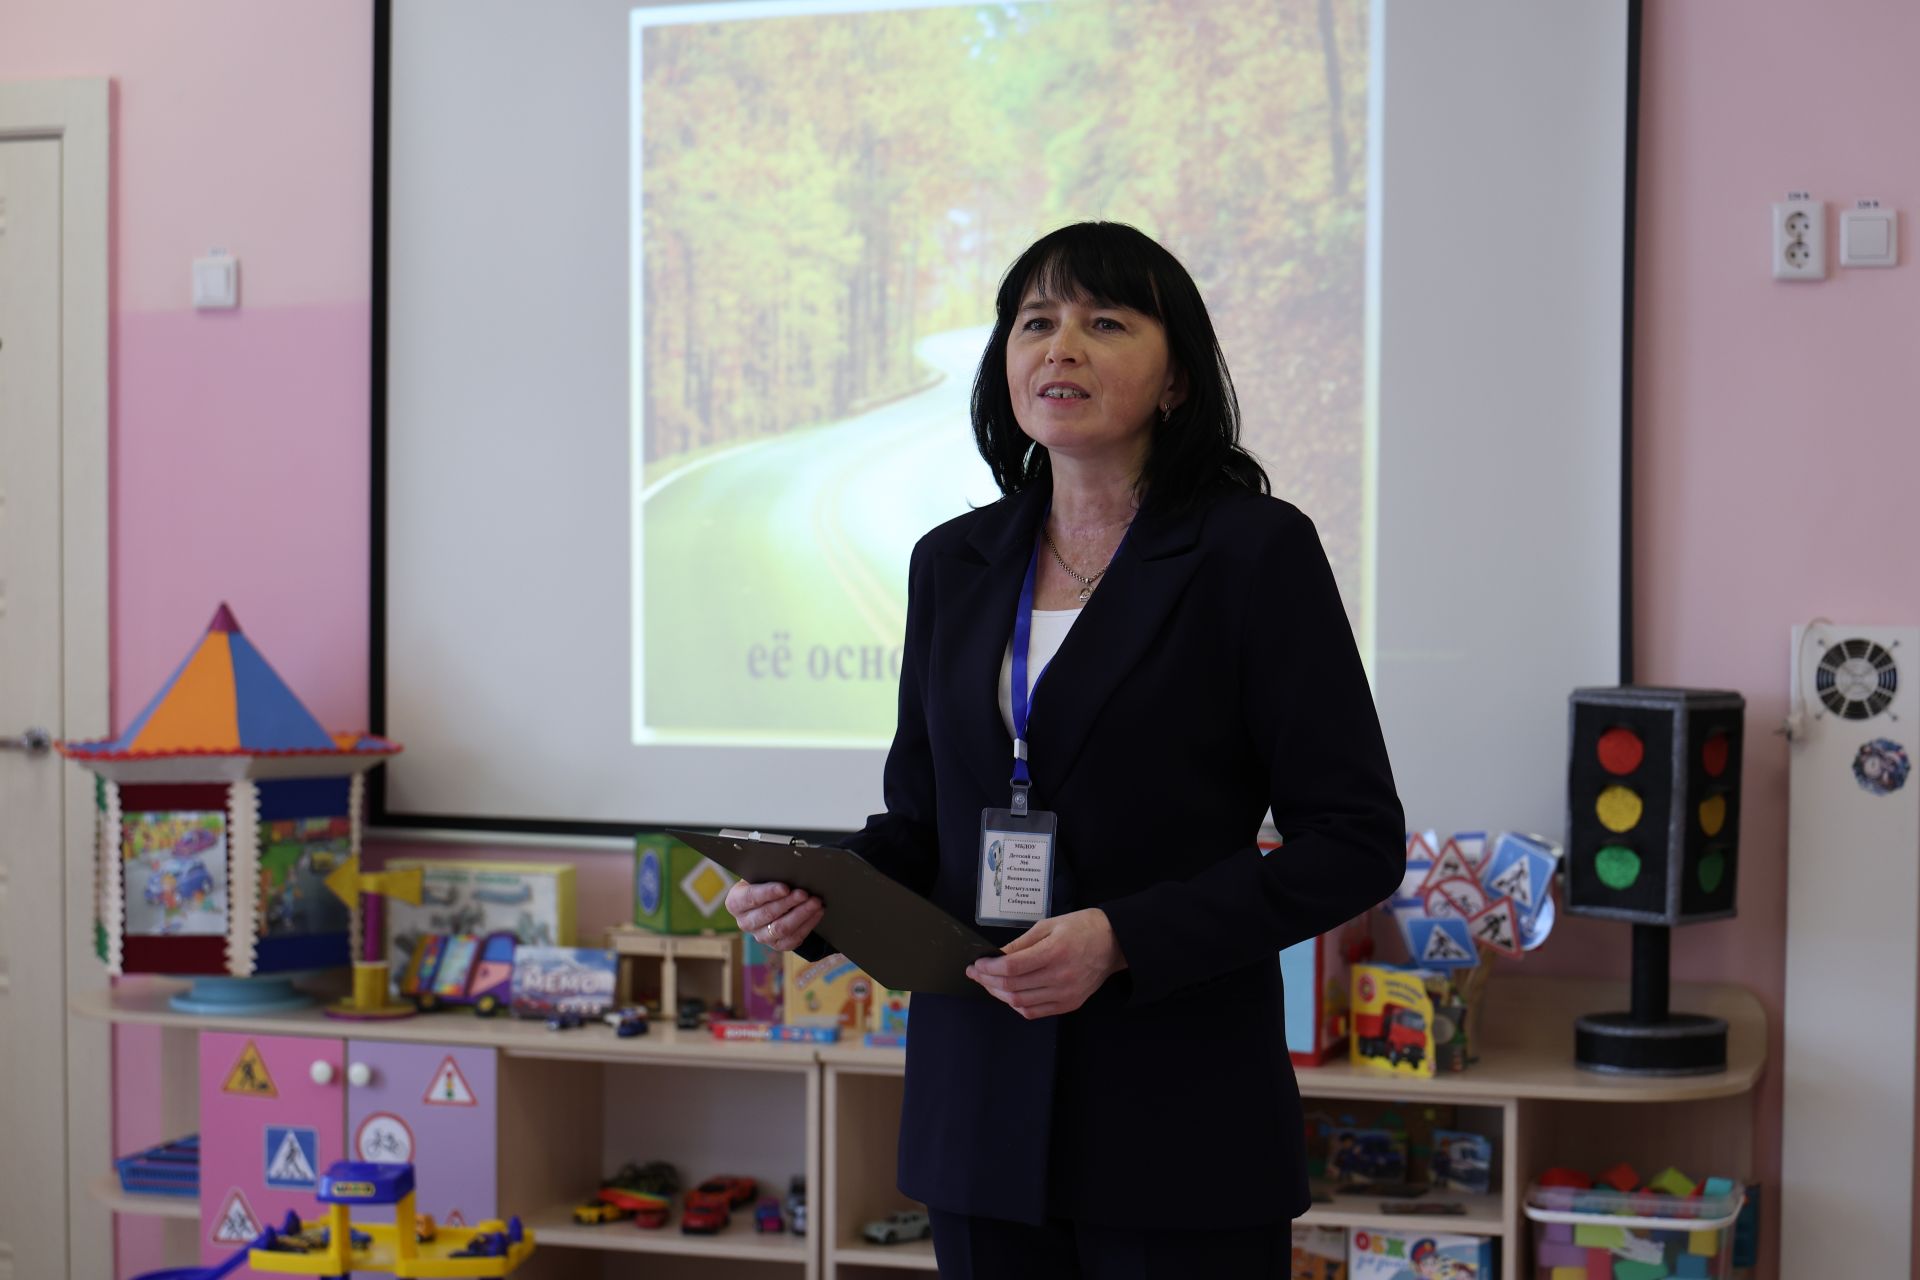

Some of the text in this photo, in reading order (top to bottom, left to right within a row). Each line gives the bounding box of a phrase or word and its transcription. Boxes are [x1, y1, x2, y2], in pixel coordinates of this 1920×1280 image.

[746, 629, 792, 681] её
[1009, 852, 1031, 860] Детский
[1355, 1231, 1406, 1260] ОБЖ
